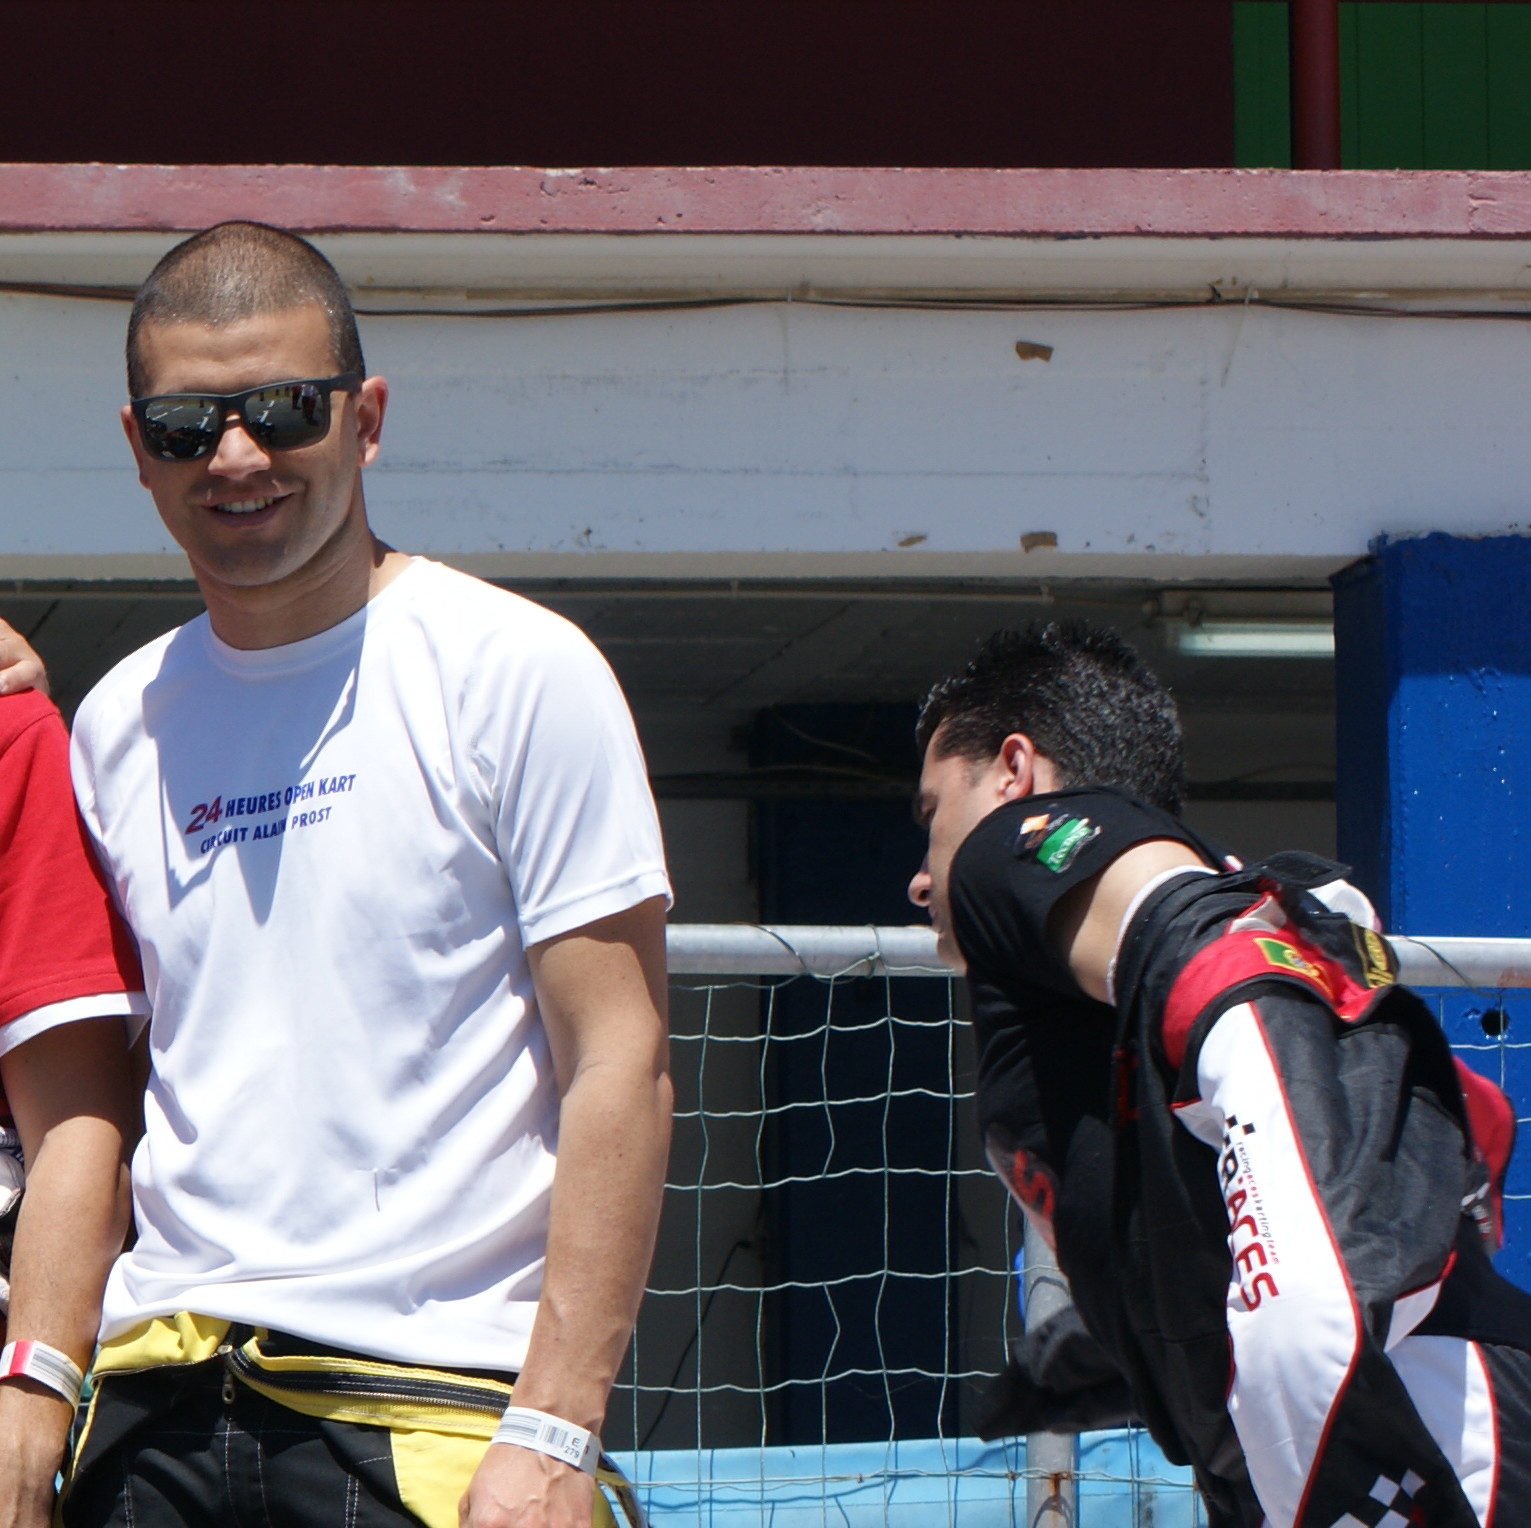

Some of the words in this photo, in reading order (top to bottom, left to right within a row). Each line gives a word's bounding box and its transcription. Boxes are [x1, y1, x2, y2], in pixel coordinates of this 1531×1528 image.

[185, 795, 223, 835] 24
[224, 790, 282, 818] HEURES
[284, 781, 315, 806] OPEN
[318, 774, 356, 796] KART
[200, 827, 248, 854] CIRCUIT
[252, 817, 287, 841] ALAIN
[291, 806, 333, 829] PROST
